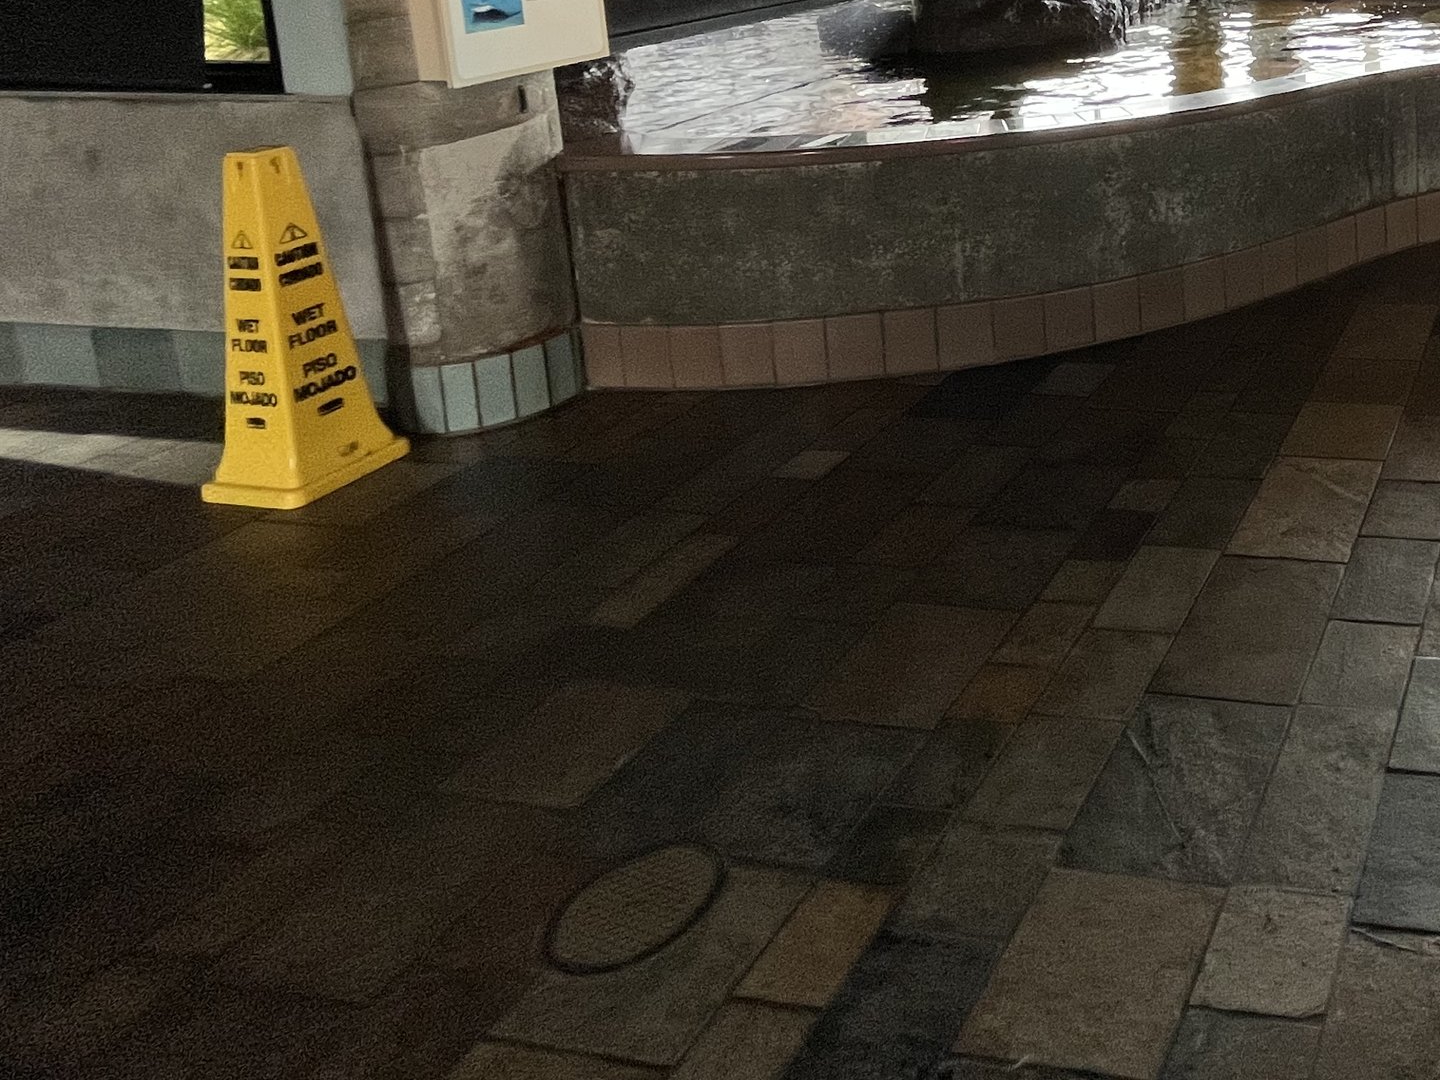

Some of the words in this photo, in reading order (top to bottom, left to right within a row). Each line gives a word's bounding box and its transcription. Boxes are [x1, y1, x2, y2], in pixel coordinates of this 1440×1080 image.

[292, 303, 325, 326] WET
[236, 319, 259, 333] WET
[288, 320, 338, 349] FLOOR
[231, 339, 267, 353] FLOOR
[303, 353, 337, 378] PISO
[239, 371, 265, 386] PISO
[294, 366, 356, 403] MOJADO
[230, 391, 277, 407] MOJADO
